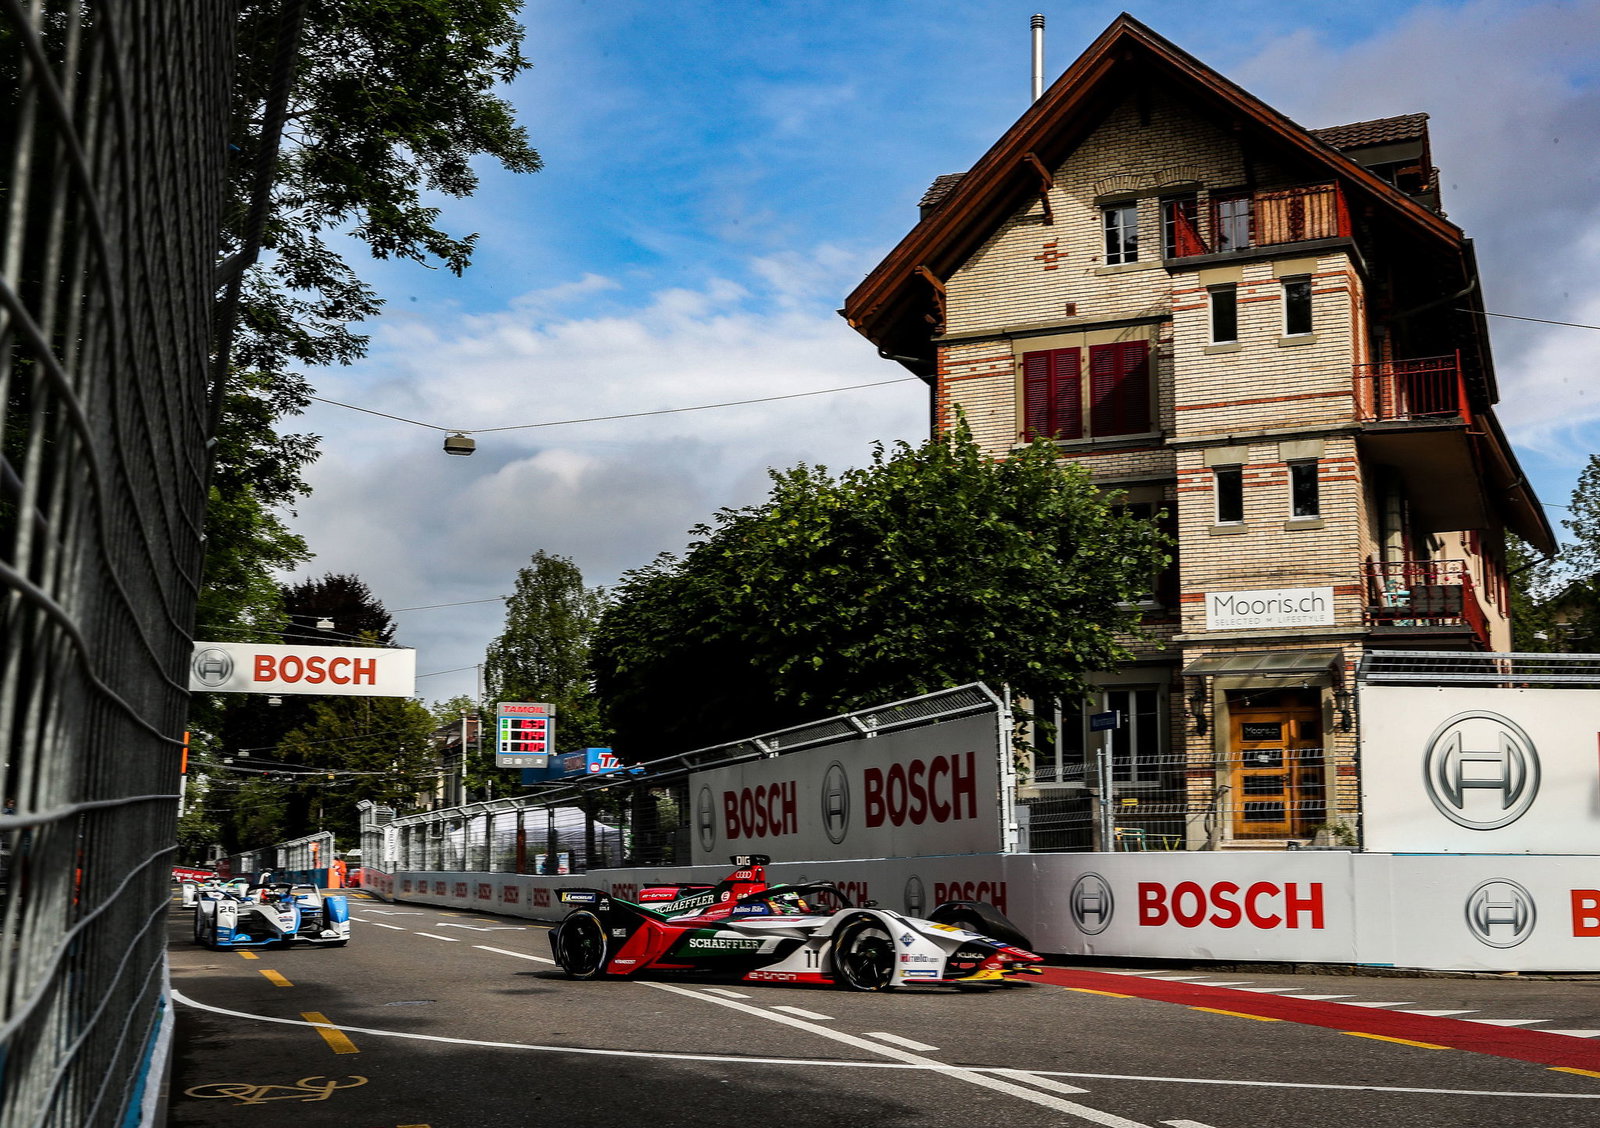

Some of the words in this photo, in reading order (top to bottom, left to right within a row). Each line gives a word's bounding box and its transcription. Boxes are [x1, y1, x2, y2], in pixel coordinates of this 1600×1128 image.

[1214, 591, 1325, 616] Mooris.ch
[1215, 617, 1261, 627] SELECTED
[1277, 614, 1325, 624] LIFESTYLE
[253, 654, 376, 686] BOSCH
[503, 705, 545, 714] TAMOIL
[864, 751, 977, 828] BOSCH
[724, 780, 798, 840] BOSCH
[732, 904, 751, 914] Julius
[1138, 881, 1325, 930] BOSCH
[689, 938, 760, 949] SCHAEFFLER
[804, 950, 820, 968] 11
[956, 951, 986, 959] KUKA
[748, 971, 797, 981] e-tron
